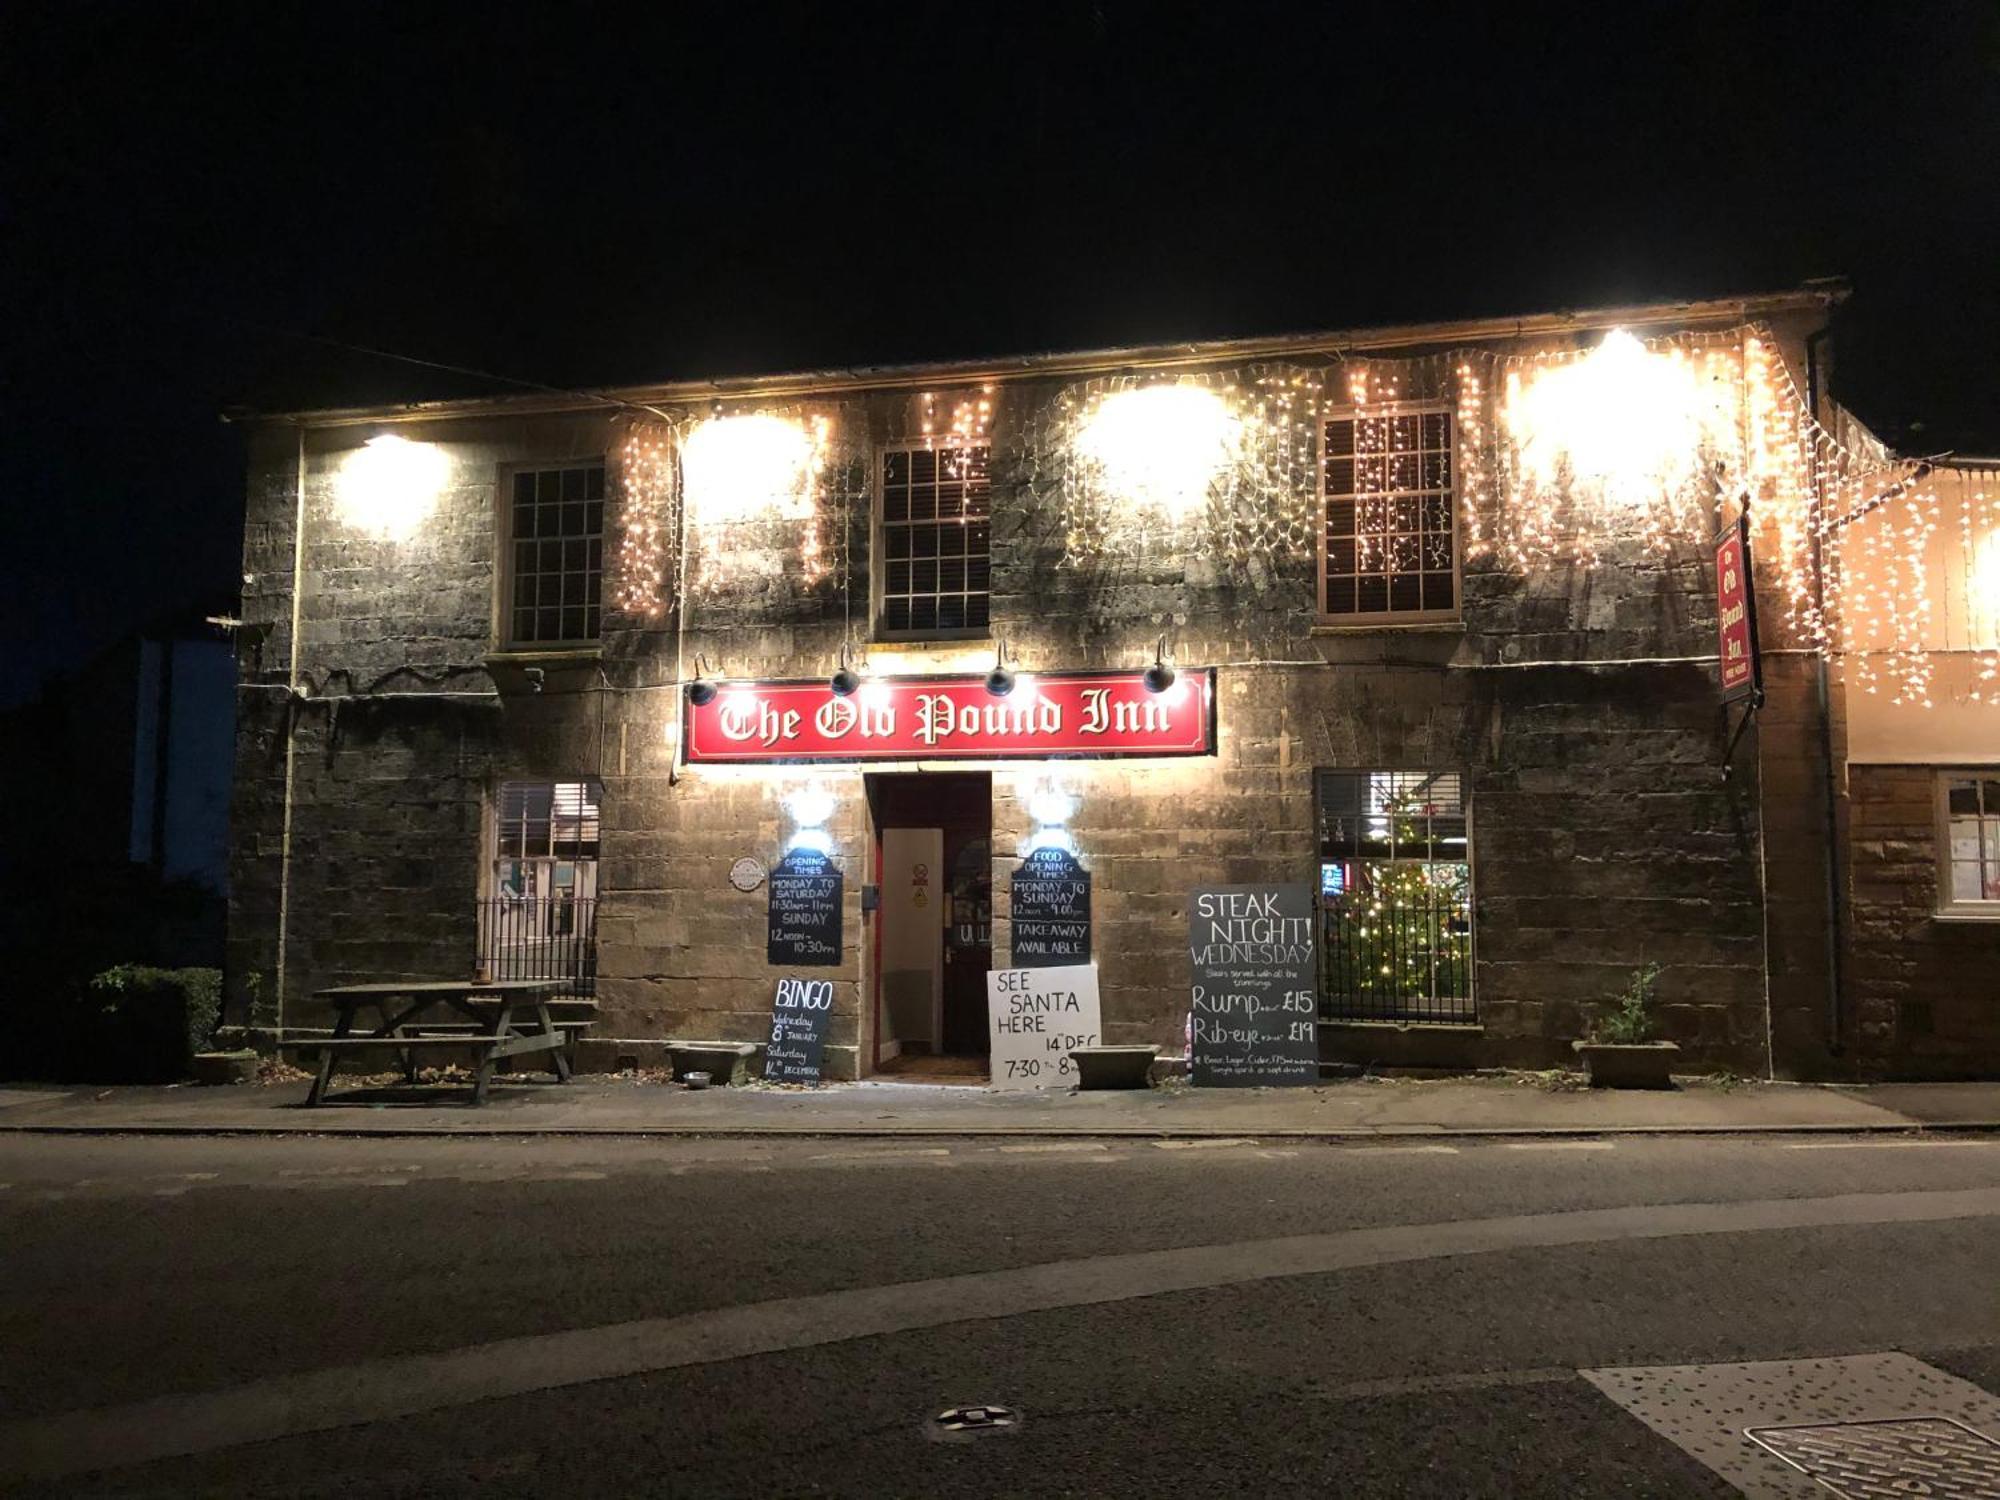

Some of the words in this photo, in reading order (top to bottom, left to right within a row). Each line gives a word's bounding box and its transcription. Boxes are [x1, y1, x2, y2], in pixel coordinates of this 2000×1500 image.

[719, 697, 802, 748] The
[815, 694, 897, 739] Old
[914, 694, 1063, 744] Pound
[1078, 688, 1171, 735] Inn
[784, 857, 827, 867] OPENING
[1034, 852, 1062, 861] FOOD
[793, 866, 823, 874] TIMES
[1024, 862, 1074, 872] OPENING
[1036, 871, 1068, 879] TIMES
[771, 879, 813, 889] MONDAY
[820, 879, 835, 889] TO
[1014, 882, 1063, 892] MONDAY
[1071, 882, 1085, 895] TO
[775, 889, 831, 899] SATURDAY
[1022, 892, 1076, 905] SUNDAY
[1197, 893, 1281, 918] STEAK
[782, 912, 829, 926] SUNDAY
[1211, 917, 1313, 945] NIGHT!
[1016, 941, 1086, 954] AVAILABLE
[1190, 942, 1314, 966] WEDNESDAY
[997, 971, 1031, 992] SEE
[775, 979, 833, 1010] BINGO
[1282, 989, 1313, 1013] £15
[1010, 991, 1080, 1014] SANTA
[997, 1015, 1047, 1033] HERE
[786, 1031, 819, 1043] JANUARY
[1288, 1021, 1314, 1043] £19
[766, 1044, 807, 1066] Saturday
